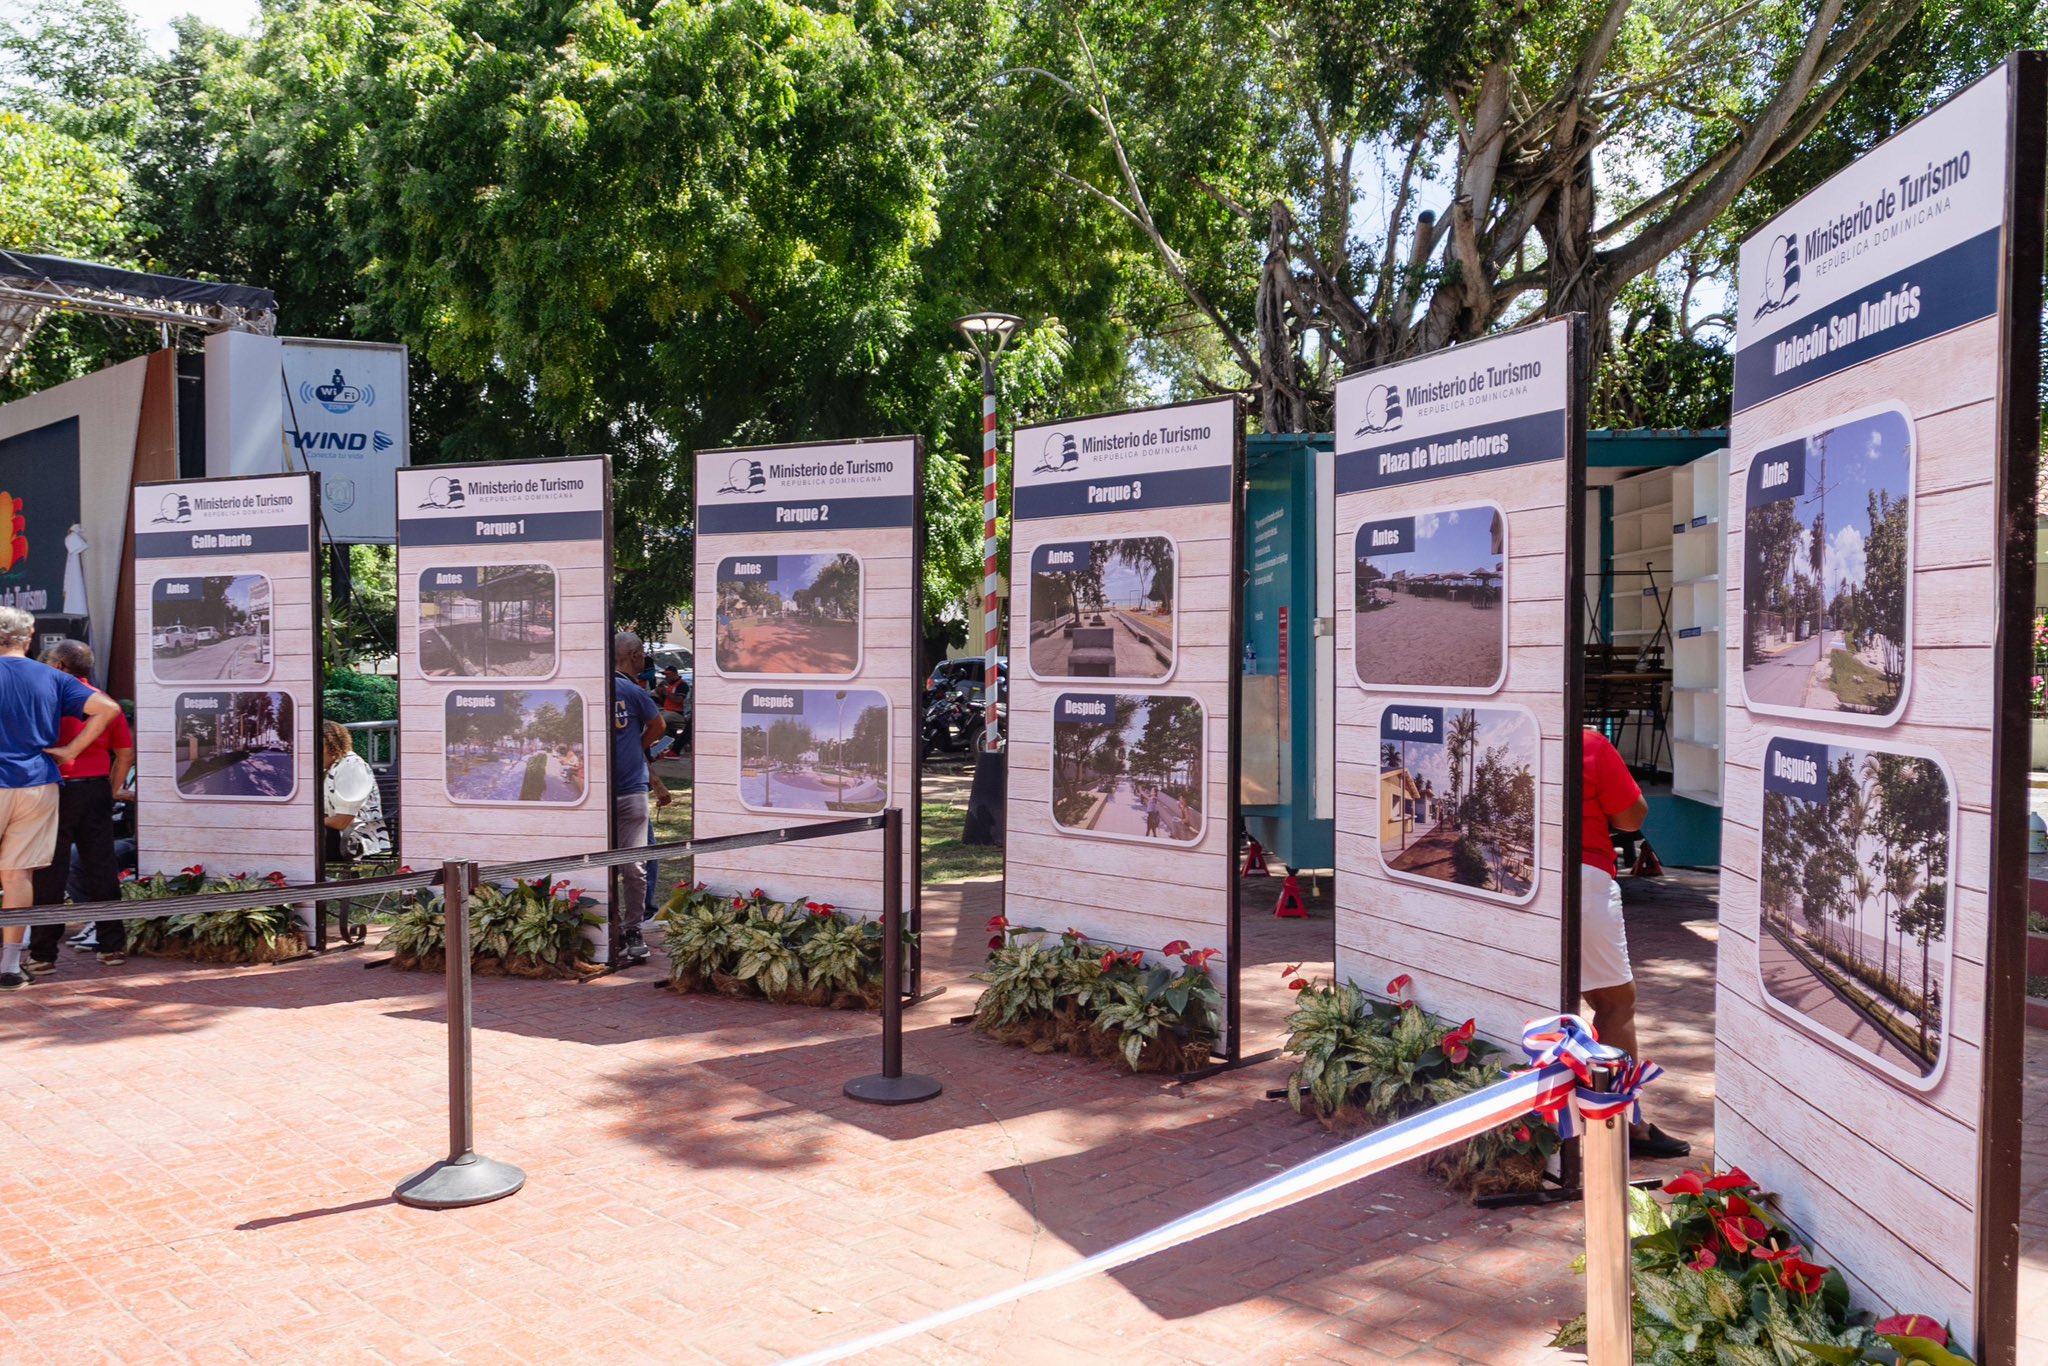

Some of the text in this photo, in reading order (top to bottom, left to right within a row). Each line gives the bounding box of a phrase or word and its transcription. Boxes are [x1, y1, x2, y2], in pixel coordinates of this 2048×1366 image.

[1805, 150, 1971, 265] Ministerio de Turismo
[1816, 197, 1951, 277] REPÚBLICA DOMINICANA
[1774, 282, 1921, 376] Malecón San Andrés
[1406, 360, 1541, 408] Ministerio de Turismo
[1418, 385, 1528, 417] REPÚBLICA DOMINICANA
[285, 430, 367, 451] WIND
[1082, 426, 1211, 454] Ministerio de Turismo
[306, 451, 337, 459] Conecta
[1093, 444, 1198, 462] REPÚBLICA DOMINICANA
[1379, 433, 1509, 475] Plaza de Vendedores
[769, 460, 893, 479] Ministerio de Turismo
[1762, 461, 1789, 489] Antes
[468, 478, 584, 496] Ministerio de Turismo
[781, 476, 882, 487] REPÚBLICA DOMINICANA
[525, 493, 573, 501] DOMINICANA
[1088, 480, 1142, 504] Parque 3
[194, 494, 293, 511] Ministerio de Turismo
[776, 504, 829, 523] Parque 2
[476, 519, 525, 536] Parque 1
[192, 533, 252, 549] Calle Duarte
[1372, 529, 1399, 547] Antes
[1047, 550, 1075, 565] Antes
[734, 562, 762, 575] Antes
[436, 572, 463, 585] Antes
[166, 582, 190, 594] Antes
[184, 697, 219, 710] Después
[456, 694, 496, 708] Después
[752, 694, 794, 709] Después
[1064, 700, 1106, 716] Después
[1391, 713, 1434, 733] Después
[1774, 750, 1818, 785] Después
